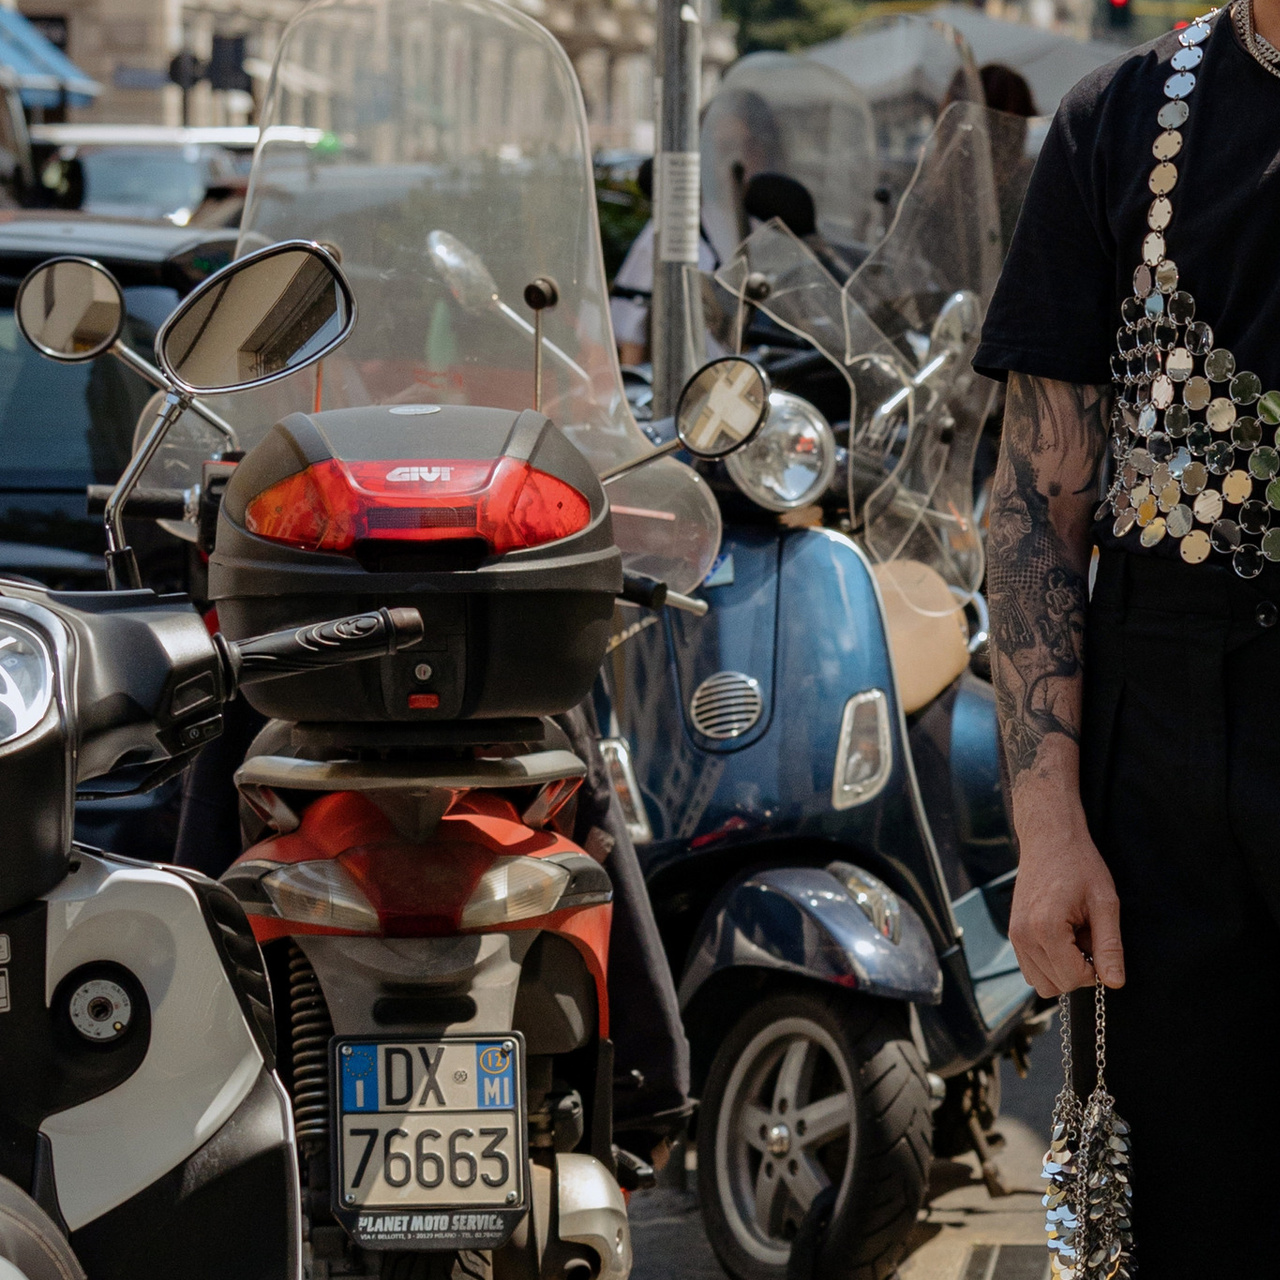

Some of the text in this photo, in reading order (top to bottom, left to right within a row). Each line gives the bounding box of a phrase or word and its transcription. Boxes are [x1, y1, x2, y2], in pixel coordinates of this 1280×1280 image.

[386, 466, 451, 482] GIVI
[384, 1047, 446, 1106] DX
[484, 1077, 510, 1106] MI
[349, 1127, 510, 1188] 76663
[358, 1214, 504, 1232] PLANET MOTO SERVICE
